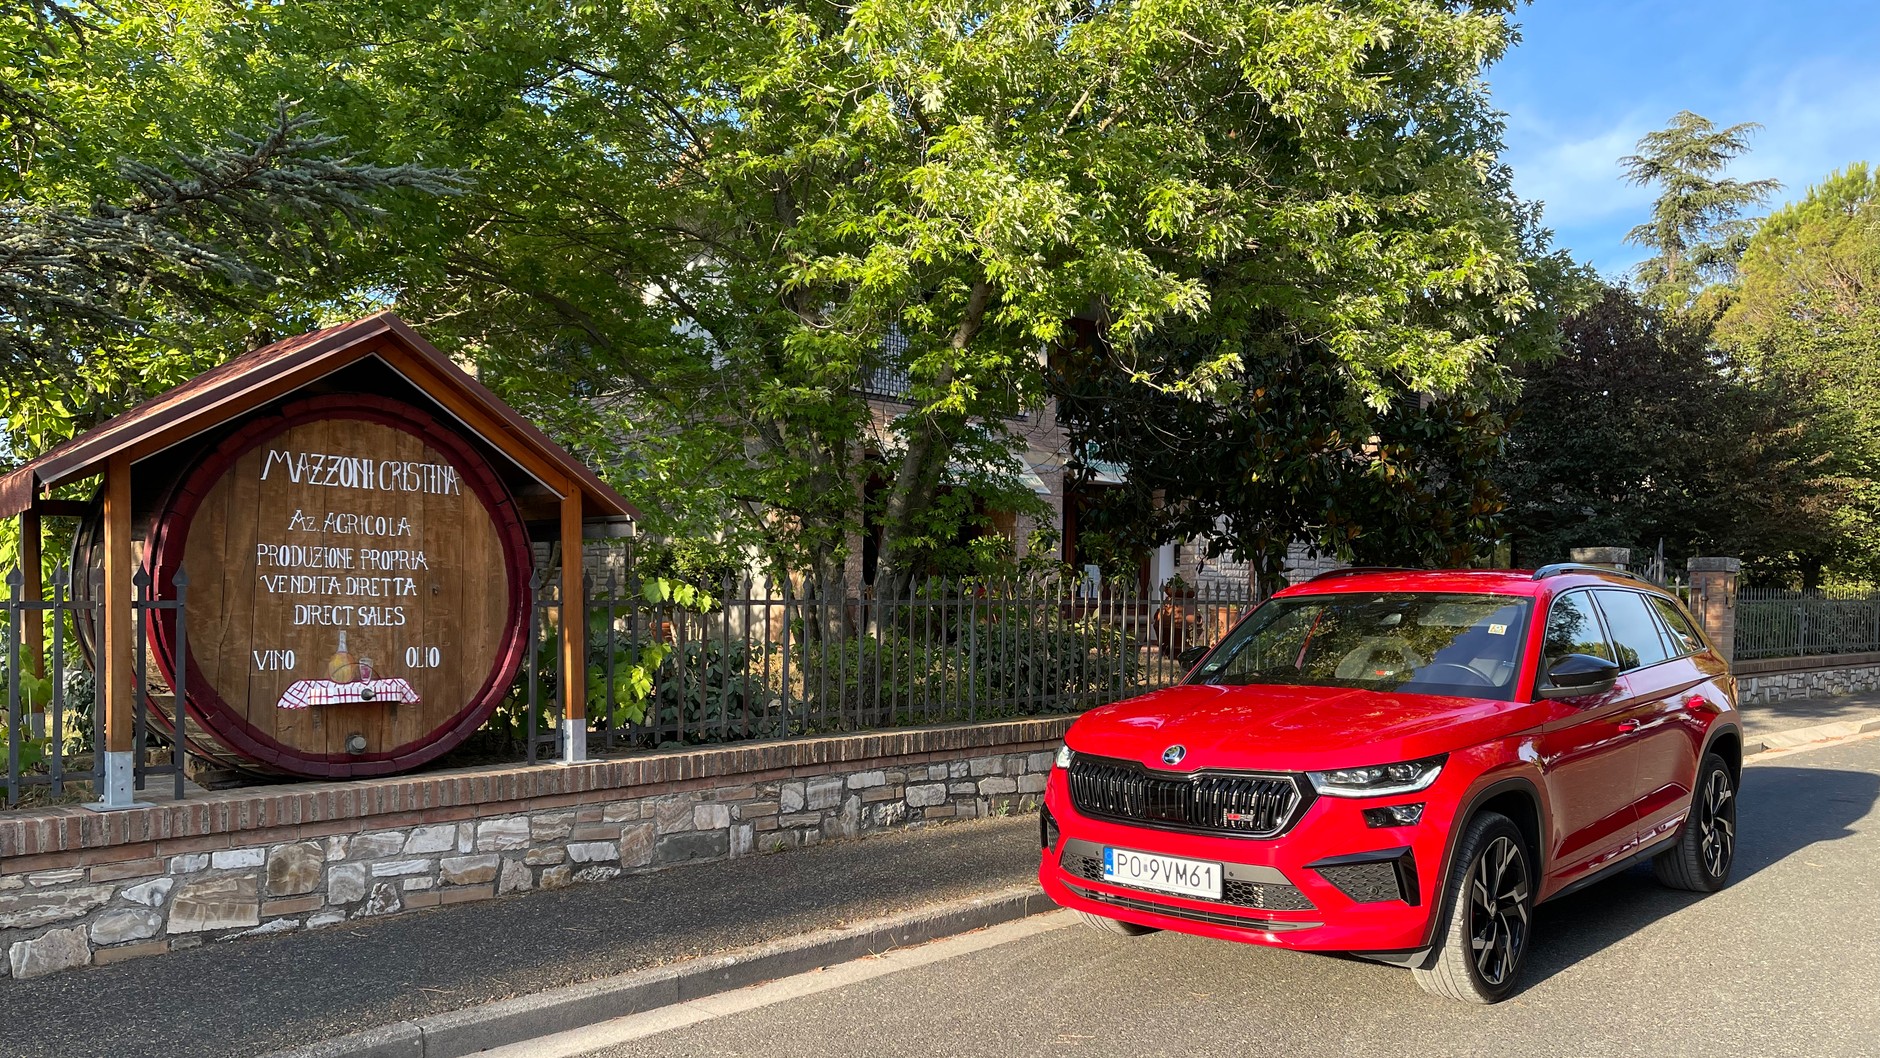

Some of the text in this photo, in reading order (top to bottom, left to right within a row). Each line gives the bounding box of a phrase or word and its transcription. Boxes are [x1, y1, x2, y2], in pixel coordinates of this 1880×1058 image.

[260, 449, 461, 496] MAZZONI CRISTINA
[323, 512, 412, 537] AGRICOLA
[256, 544, 429, 571] PRODUZIONE PROPRIA
[260, 575, 418, 597] VENDITA DIRETTA
[294, 605, 406, 626] DIRECT SALES
[253, 650, 296, 671] VINO
[405, 646, 440, 669] OLIO
[1149, 859, 1212, 890] 9VM61
